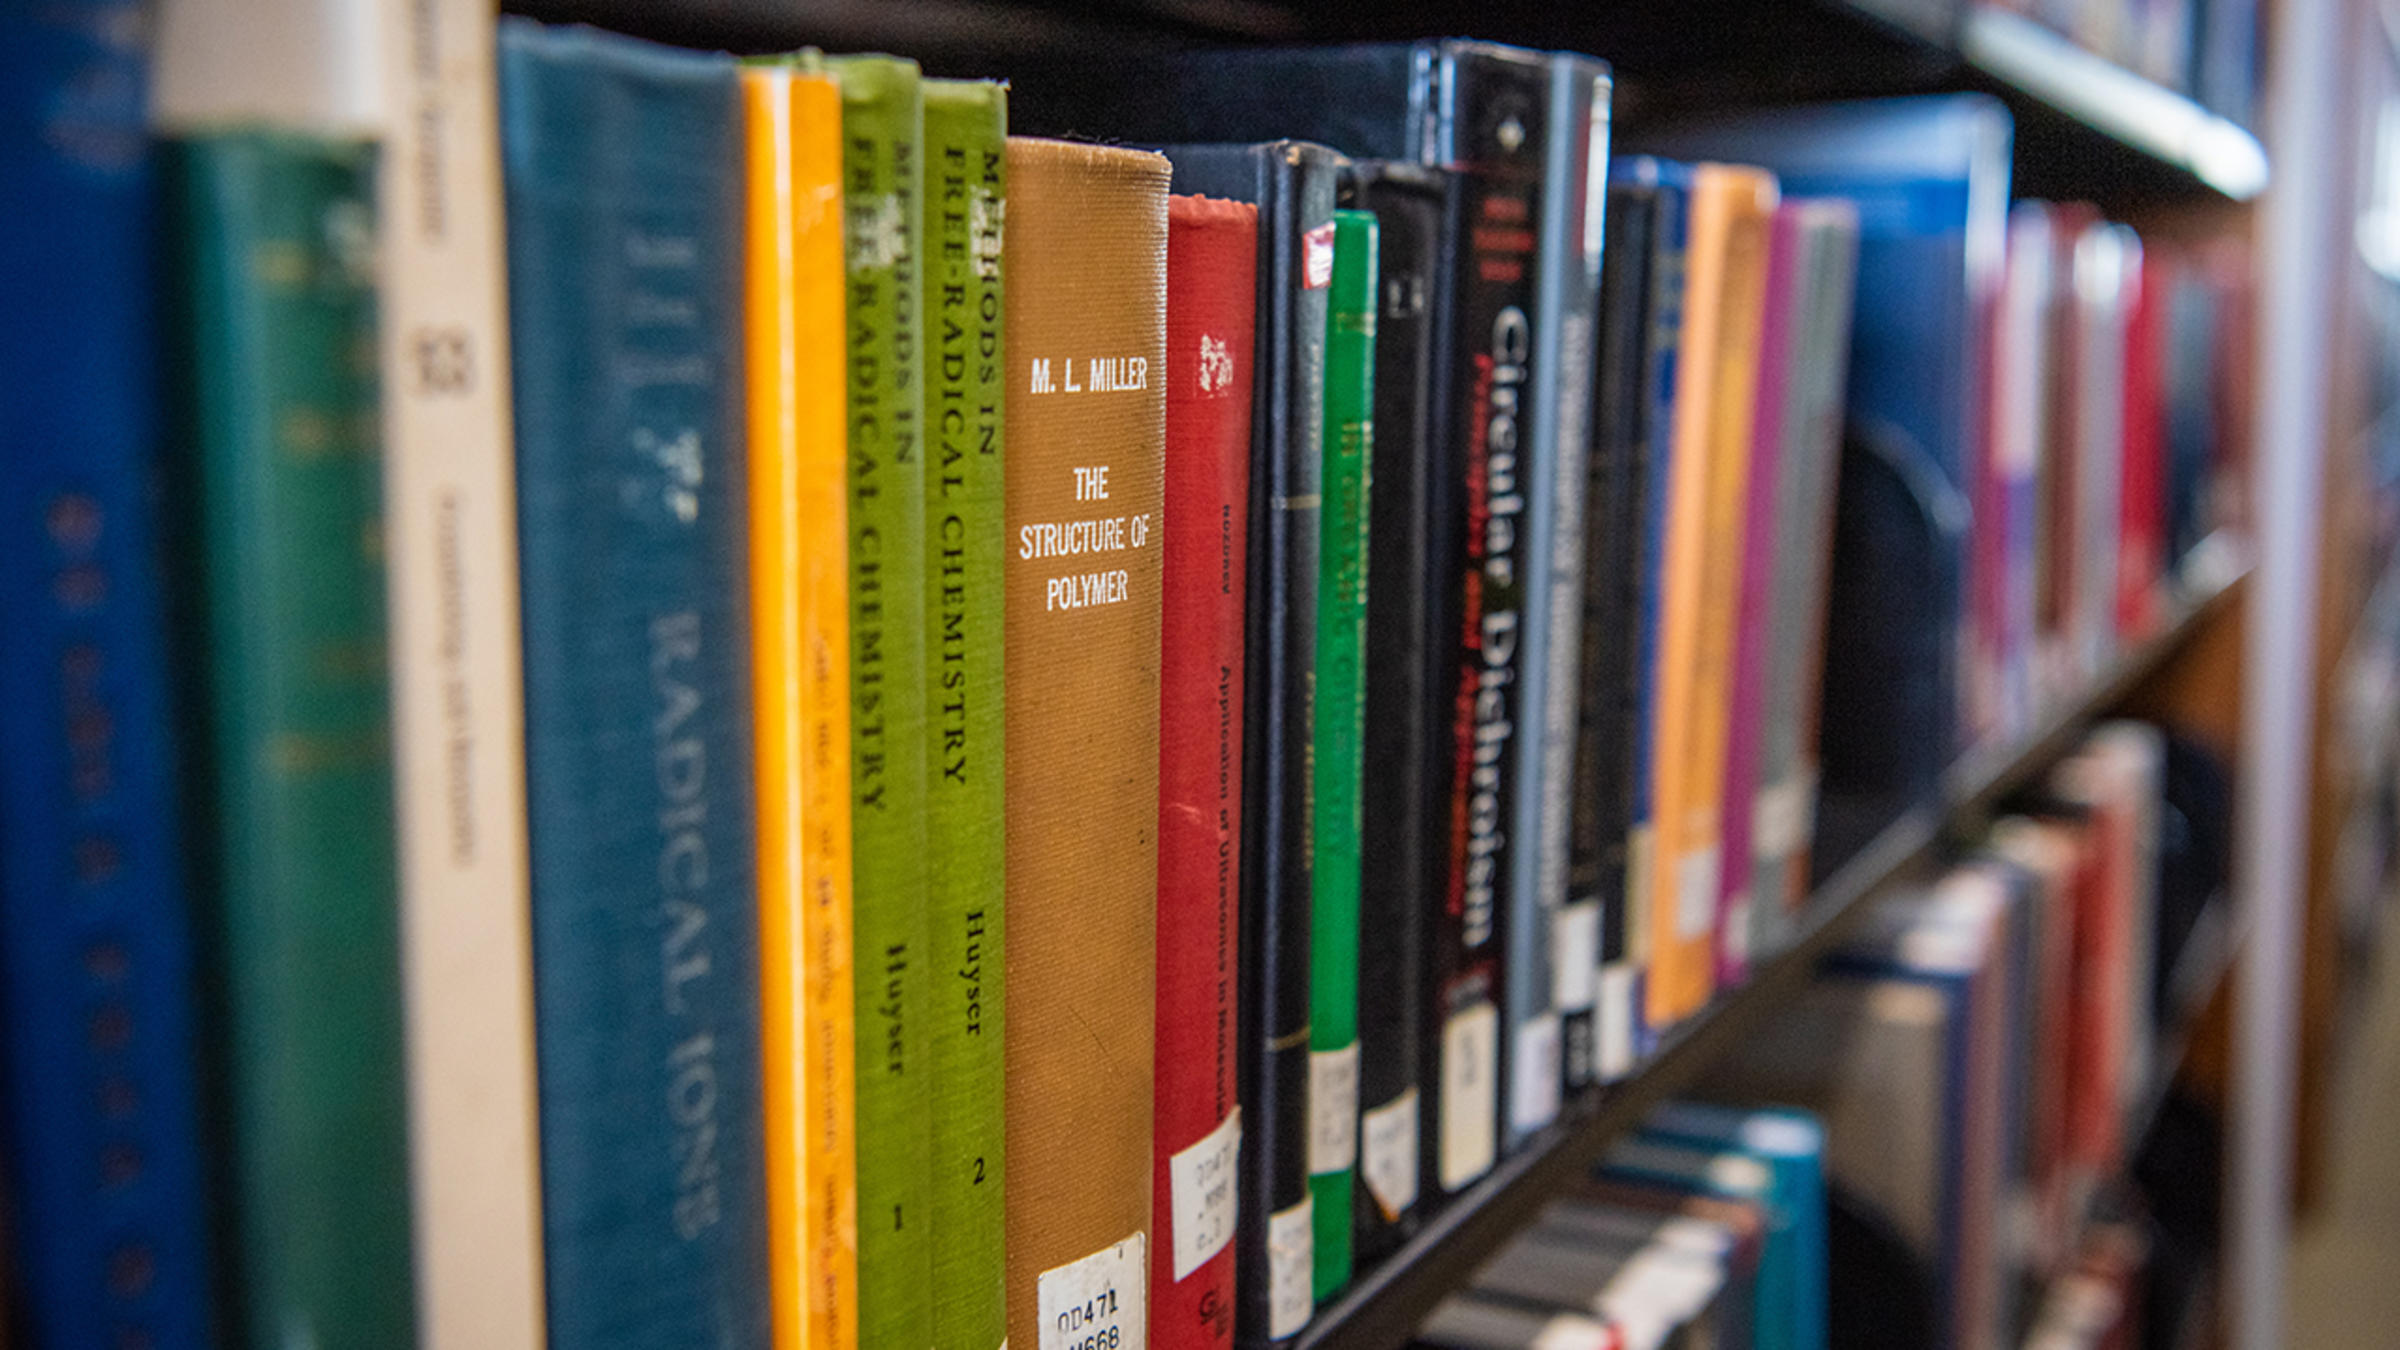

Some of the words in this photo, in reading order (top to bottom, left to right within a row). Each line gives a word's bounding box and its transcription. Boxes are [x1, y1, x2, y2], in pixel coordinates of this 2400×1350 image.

[941, 145, 967, 498] FREE-RADICAL
[979, 149, 1001, 387] METHODS
[894, 408, 915, 465] IN
[976, 404, 997, 456] IN
[1031, 357, 1056, 394] M.
[1089, 356, 1148, 392] MILLER
[1073, 465, 1110, 501] THE
[1488, 304, 1530, 587] Circular
[1019, 516, 1126, 560] STRUCTURE
[1131, 514, 1151, 549] OF
[1046, 569, 1129, 612] POLYMER
[856, 526, 885, 811] CHEMISTRY
[941, 513, 967, 785] CHEMISTRY
[646, 611, 711, 1017] RADICAL
[1462, 608, 1518, 948] Dichroism
[878, 944, 907, 1076] Huyser
[959, 910, 985, 1036] Huyser
[893, 1203, 904, 1232] 1
[973, 1157, 987, 1186] 2
